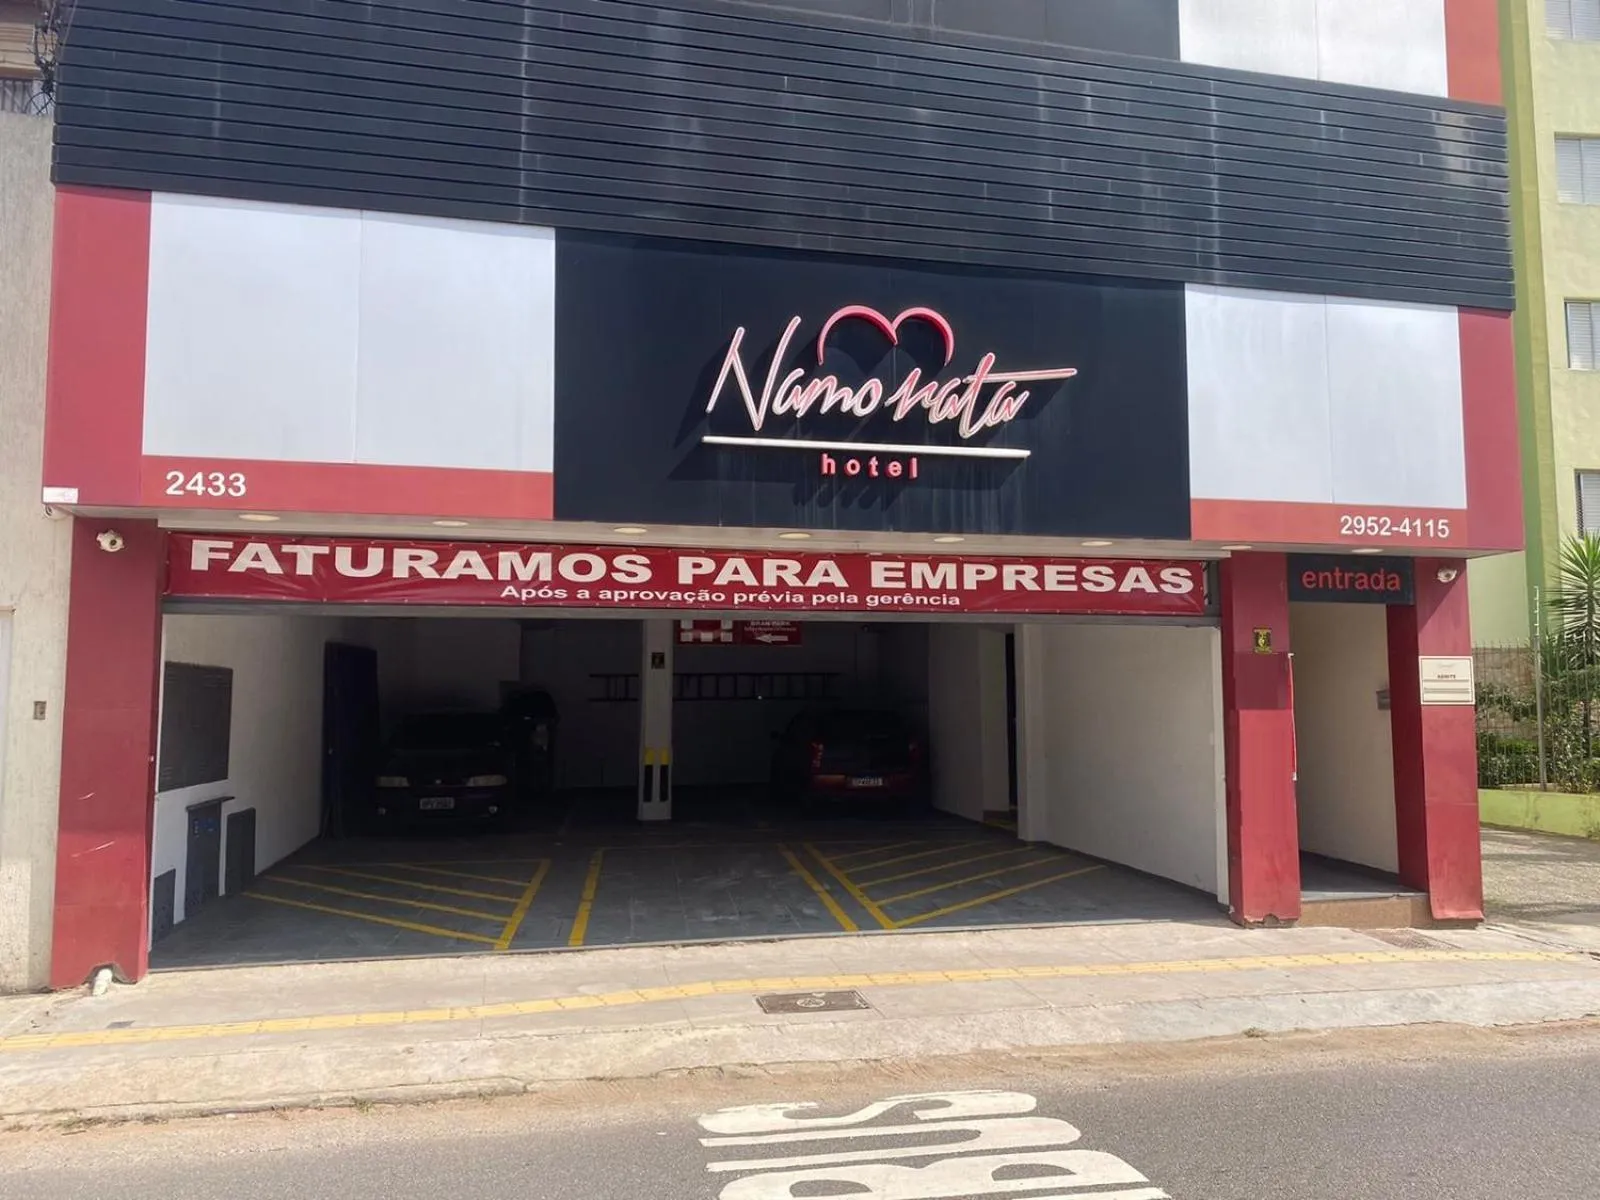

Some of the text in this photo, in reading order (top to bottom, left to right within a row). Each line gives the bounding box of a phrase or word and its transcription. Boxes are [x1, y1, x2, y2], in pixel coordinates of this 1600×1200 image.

[819, 452, 920, 479] hotel
[165, 470, 247, 497] 2433
[1340, 515, 1450, 538] 2952-4115
[190, 538, 1194, 594] FATURAMOS PARA EMPRESAS
[1301, 566, 1401, 591] entrada
[500, 585, 960, 607] Após a aprovação prévia pela gerência
